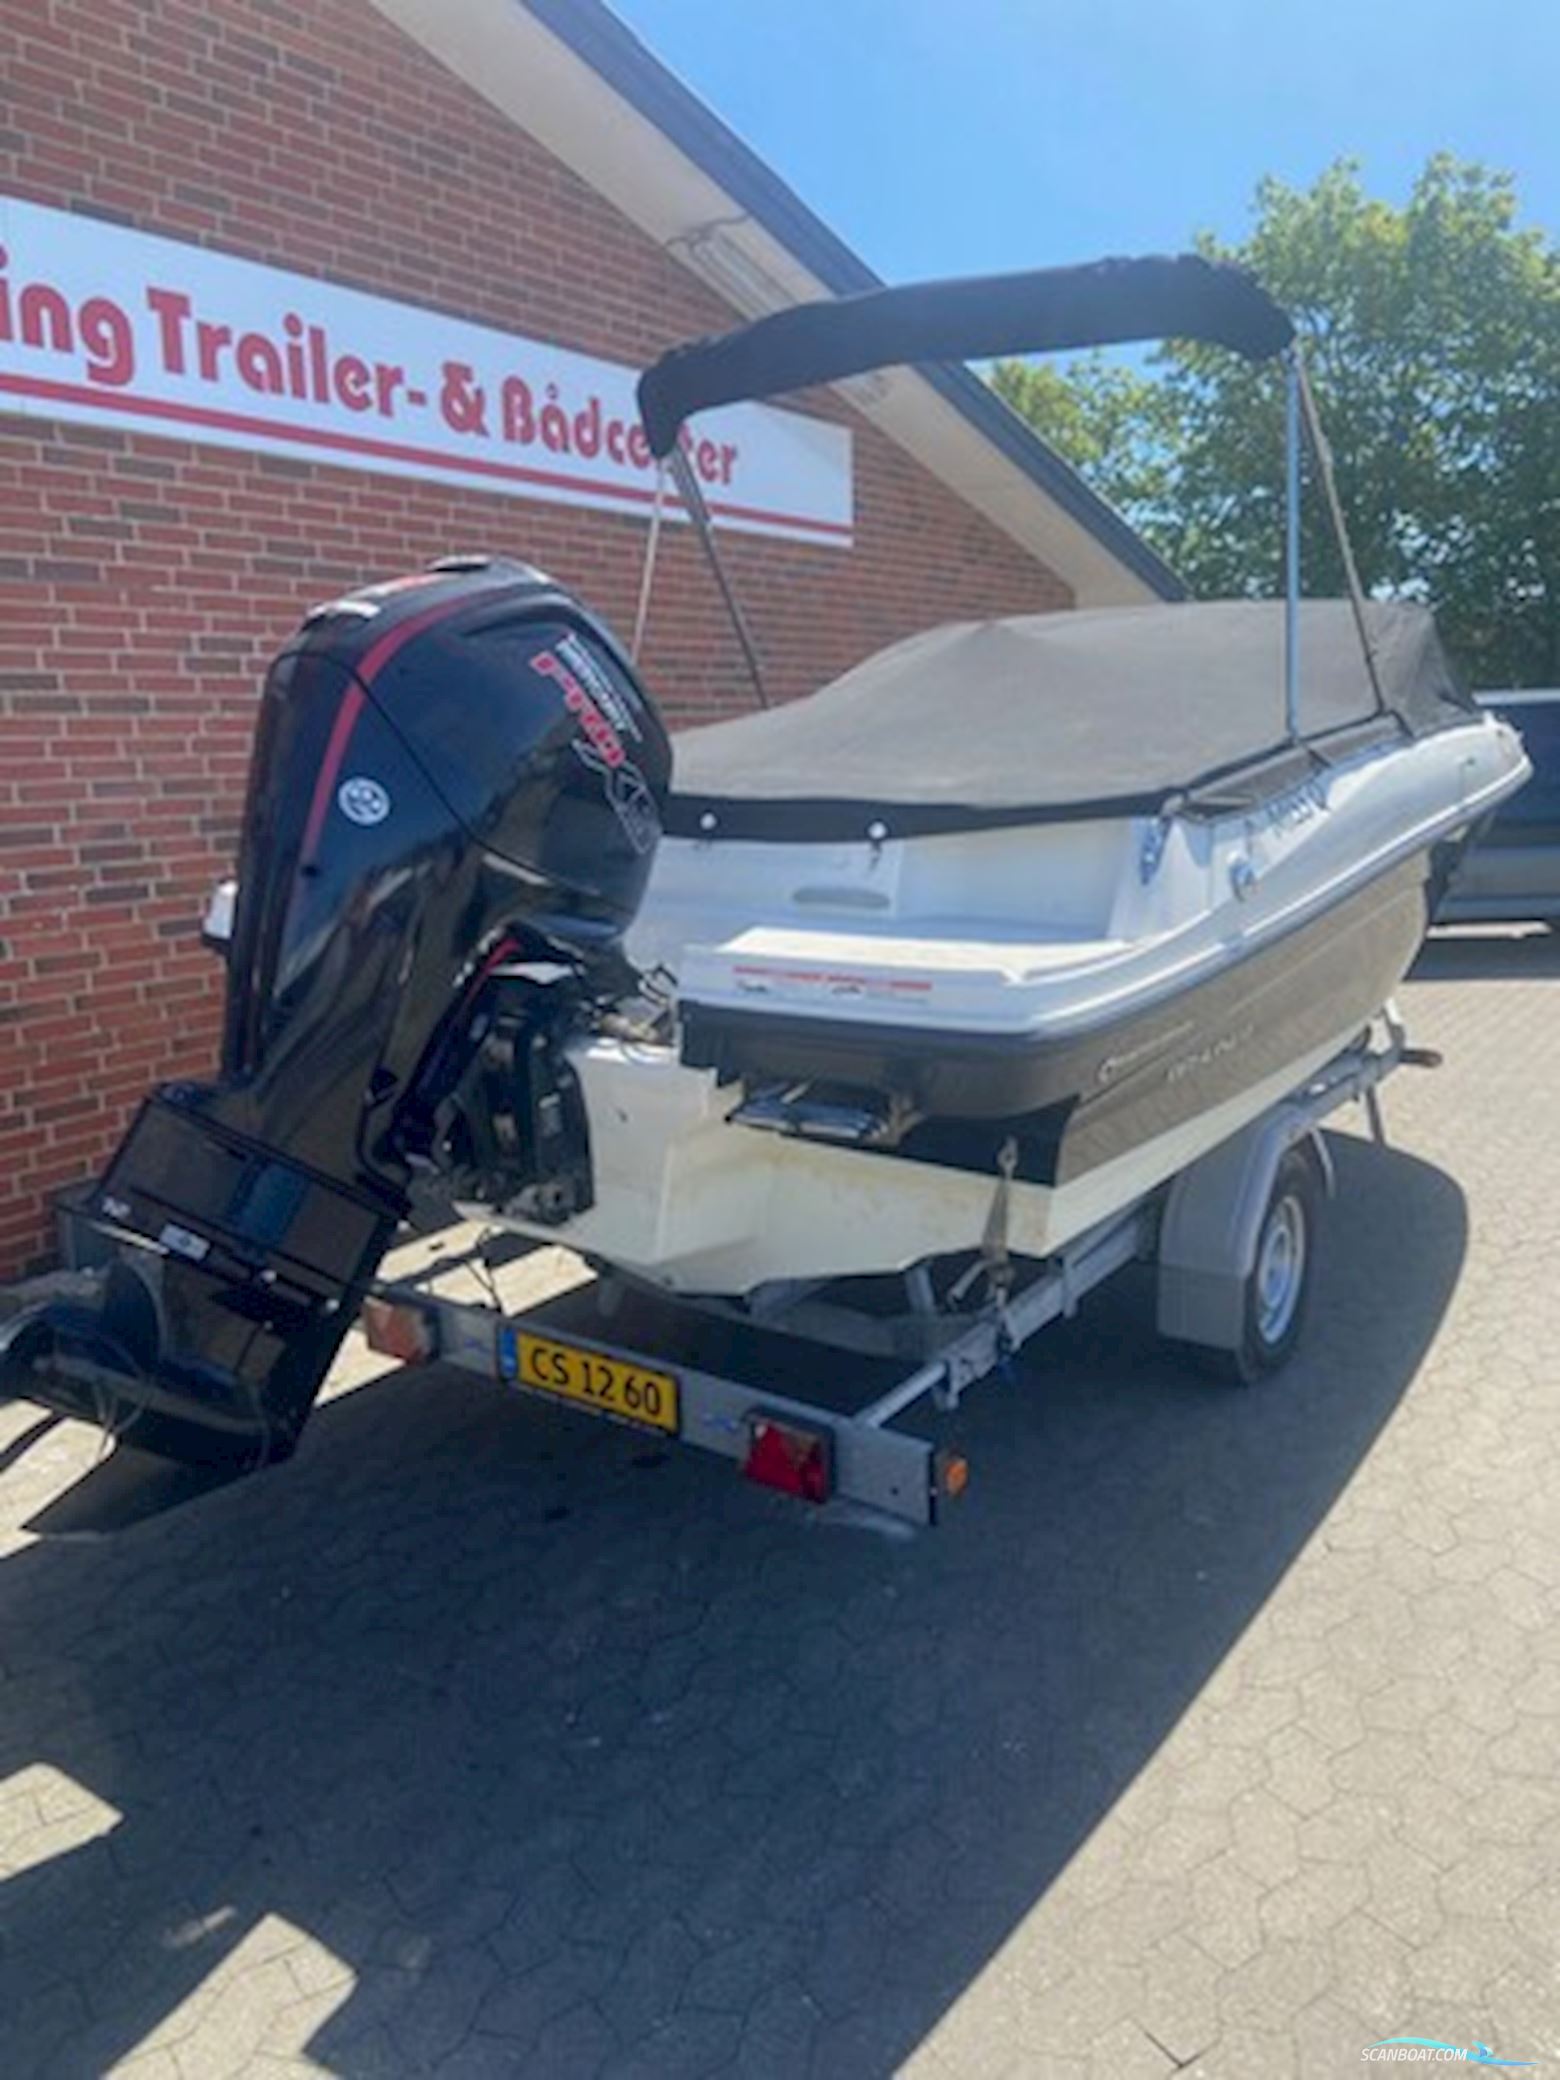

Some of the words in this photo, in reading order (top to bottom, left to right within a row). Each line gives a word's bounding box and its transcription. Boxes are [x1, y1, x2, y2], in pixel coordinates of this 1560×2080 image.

[146, 285, 428, 419] Trailer-
[441, 360, 490, 438] &
[530, 1347, 569, 1386] CS
[581, 1361, 615, 1402] 12
[624, 1375, 661, 1416] 60
